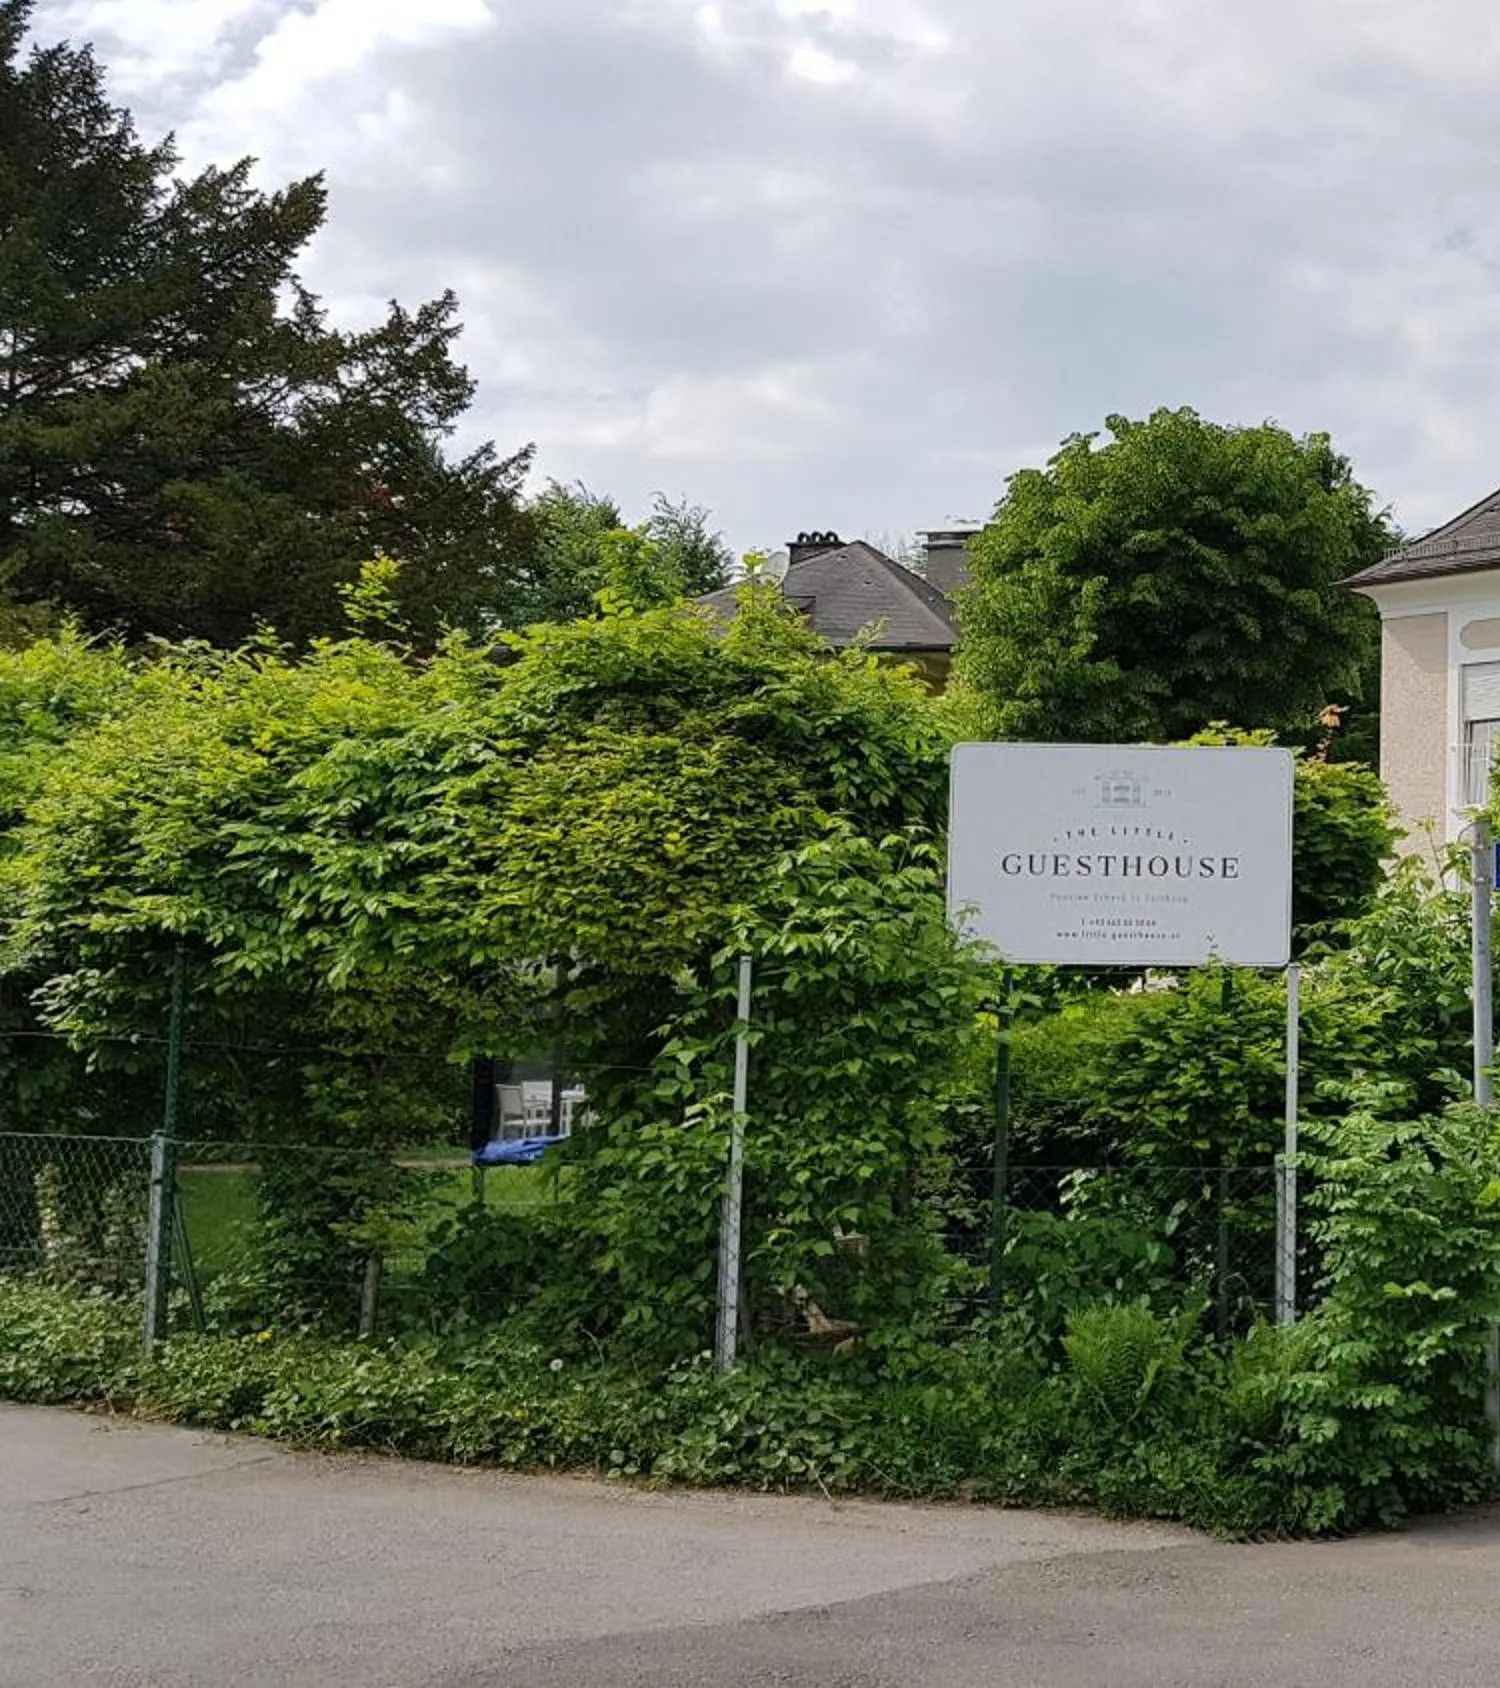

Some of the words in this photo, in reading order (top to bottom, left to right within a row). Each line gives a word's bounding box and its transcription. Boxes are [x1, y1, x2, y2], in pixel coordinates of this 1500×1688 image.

[1065, 825, 1098, 840] THE
[1110, 824, 1175, 841] LITTLE
[1001, 853, 1240, 879] GUESTHOUSE
